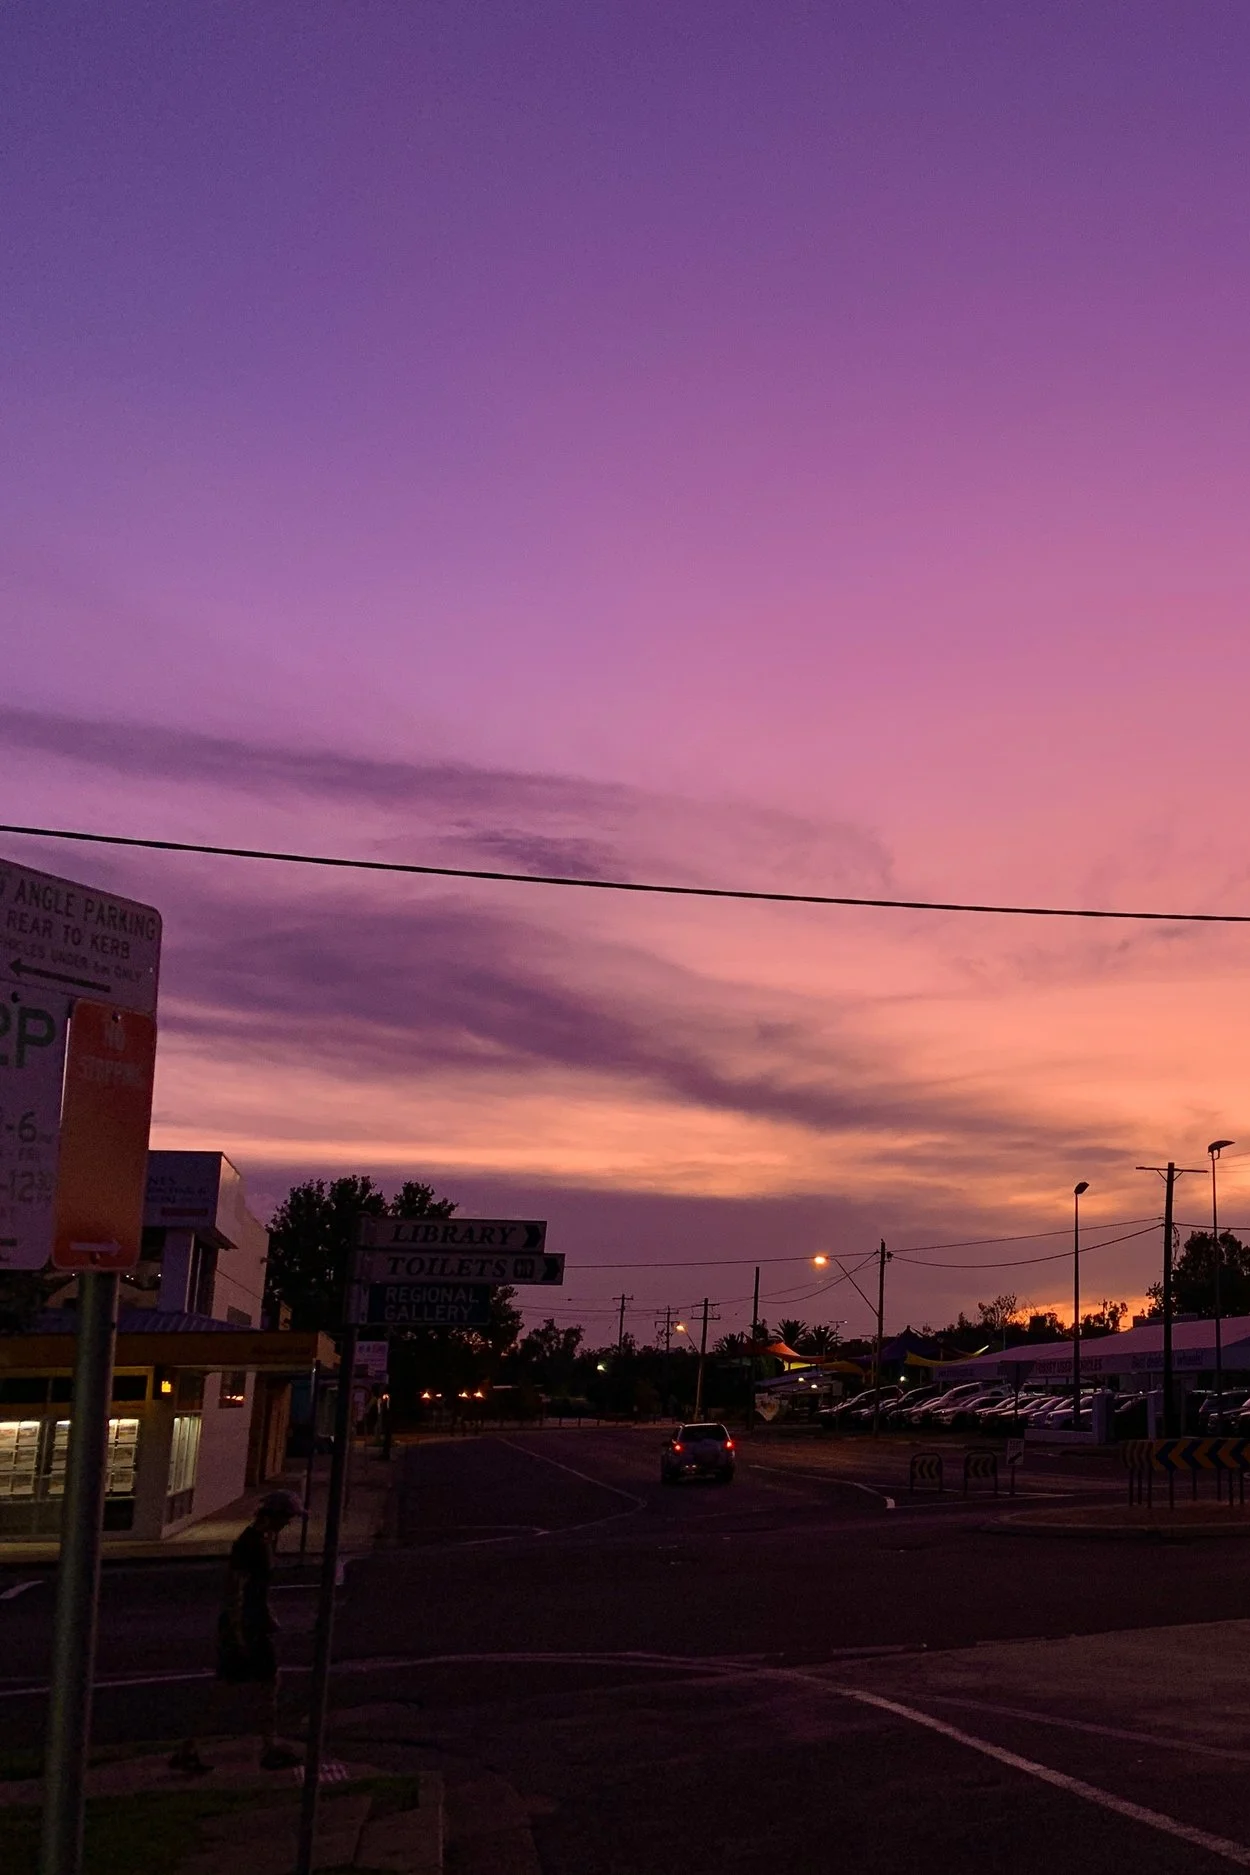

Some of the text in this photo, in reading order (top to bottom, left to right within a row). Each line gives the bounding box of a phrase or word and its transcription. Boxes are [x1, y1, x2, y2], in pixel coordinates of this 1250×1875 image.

[15, 878, 156, 941] ANGLE PARKING
[7, 909, 130, 960] REAR TO KERB
[389, 1223, 517, 1246] LIBRARY
[387, 1256, 508, 1279] TOILETS
[385, 1285, 481, 1305] REGIONAL
[383, 1303, 475, 1322] GALLERY
